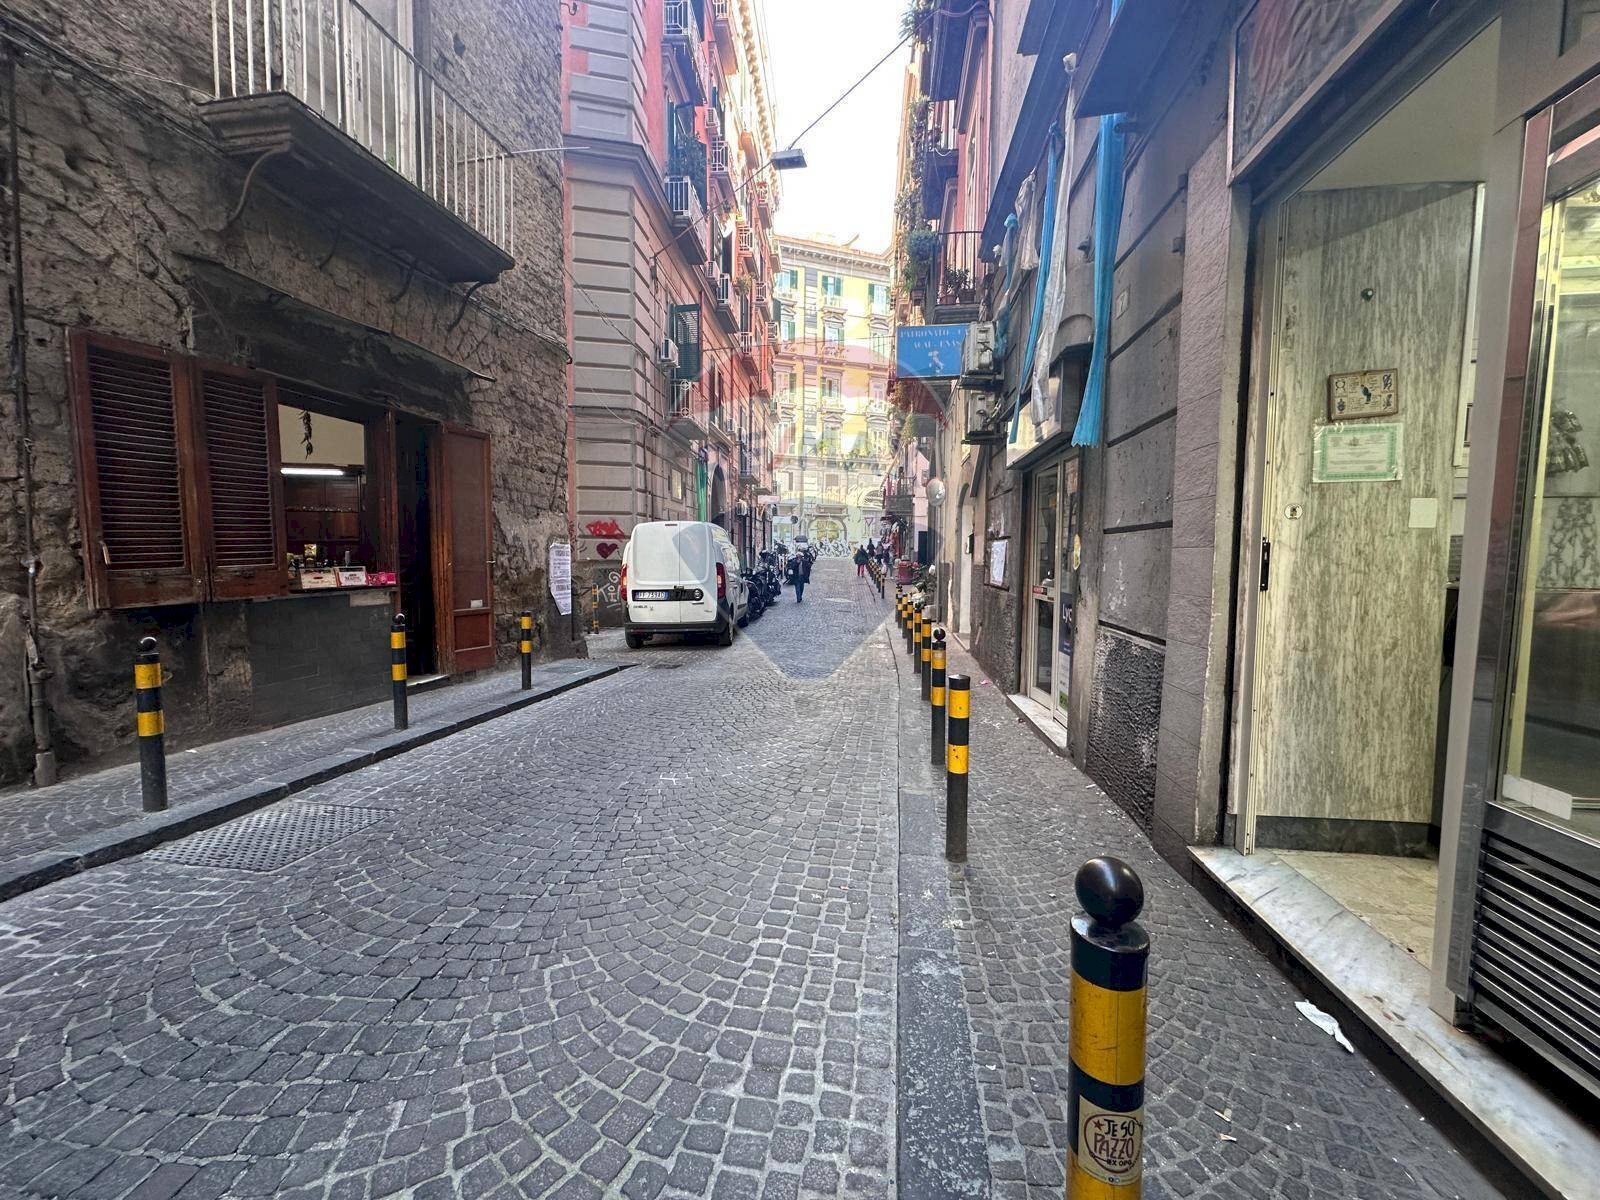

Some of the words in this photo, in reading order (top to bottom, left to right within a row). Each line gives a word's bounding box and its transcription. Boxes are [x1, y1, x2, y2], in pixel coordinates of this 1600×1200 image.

[900, 329, 949, 338] PATRONATO
[1104, 1118, 1118, 1137] JE
[1121, 1120, 1135, 1138] SO
[1094, 1132, 1134, 1160] PAZZO
